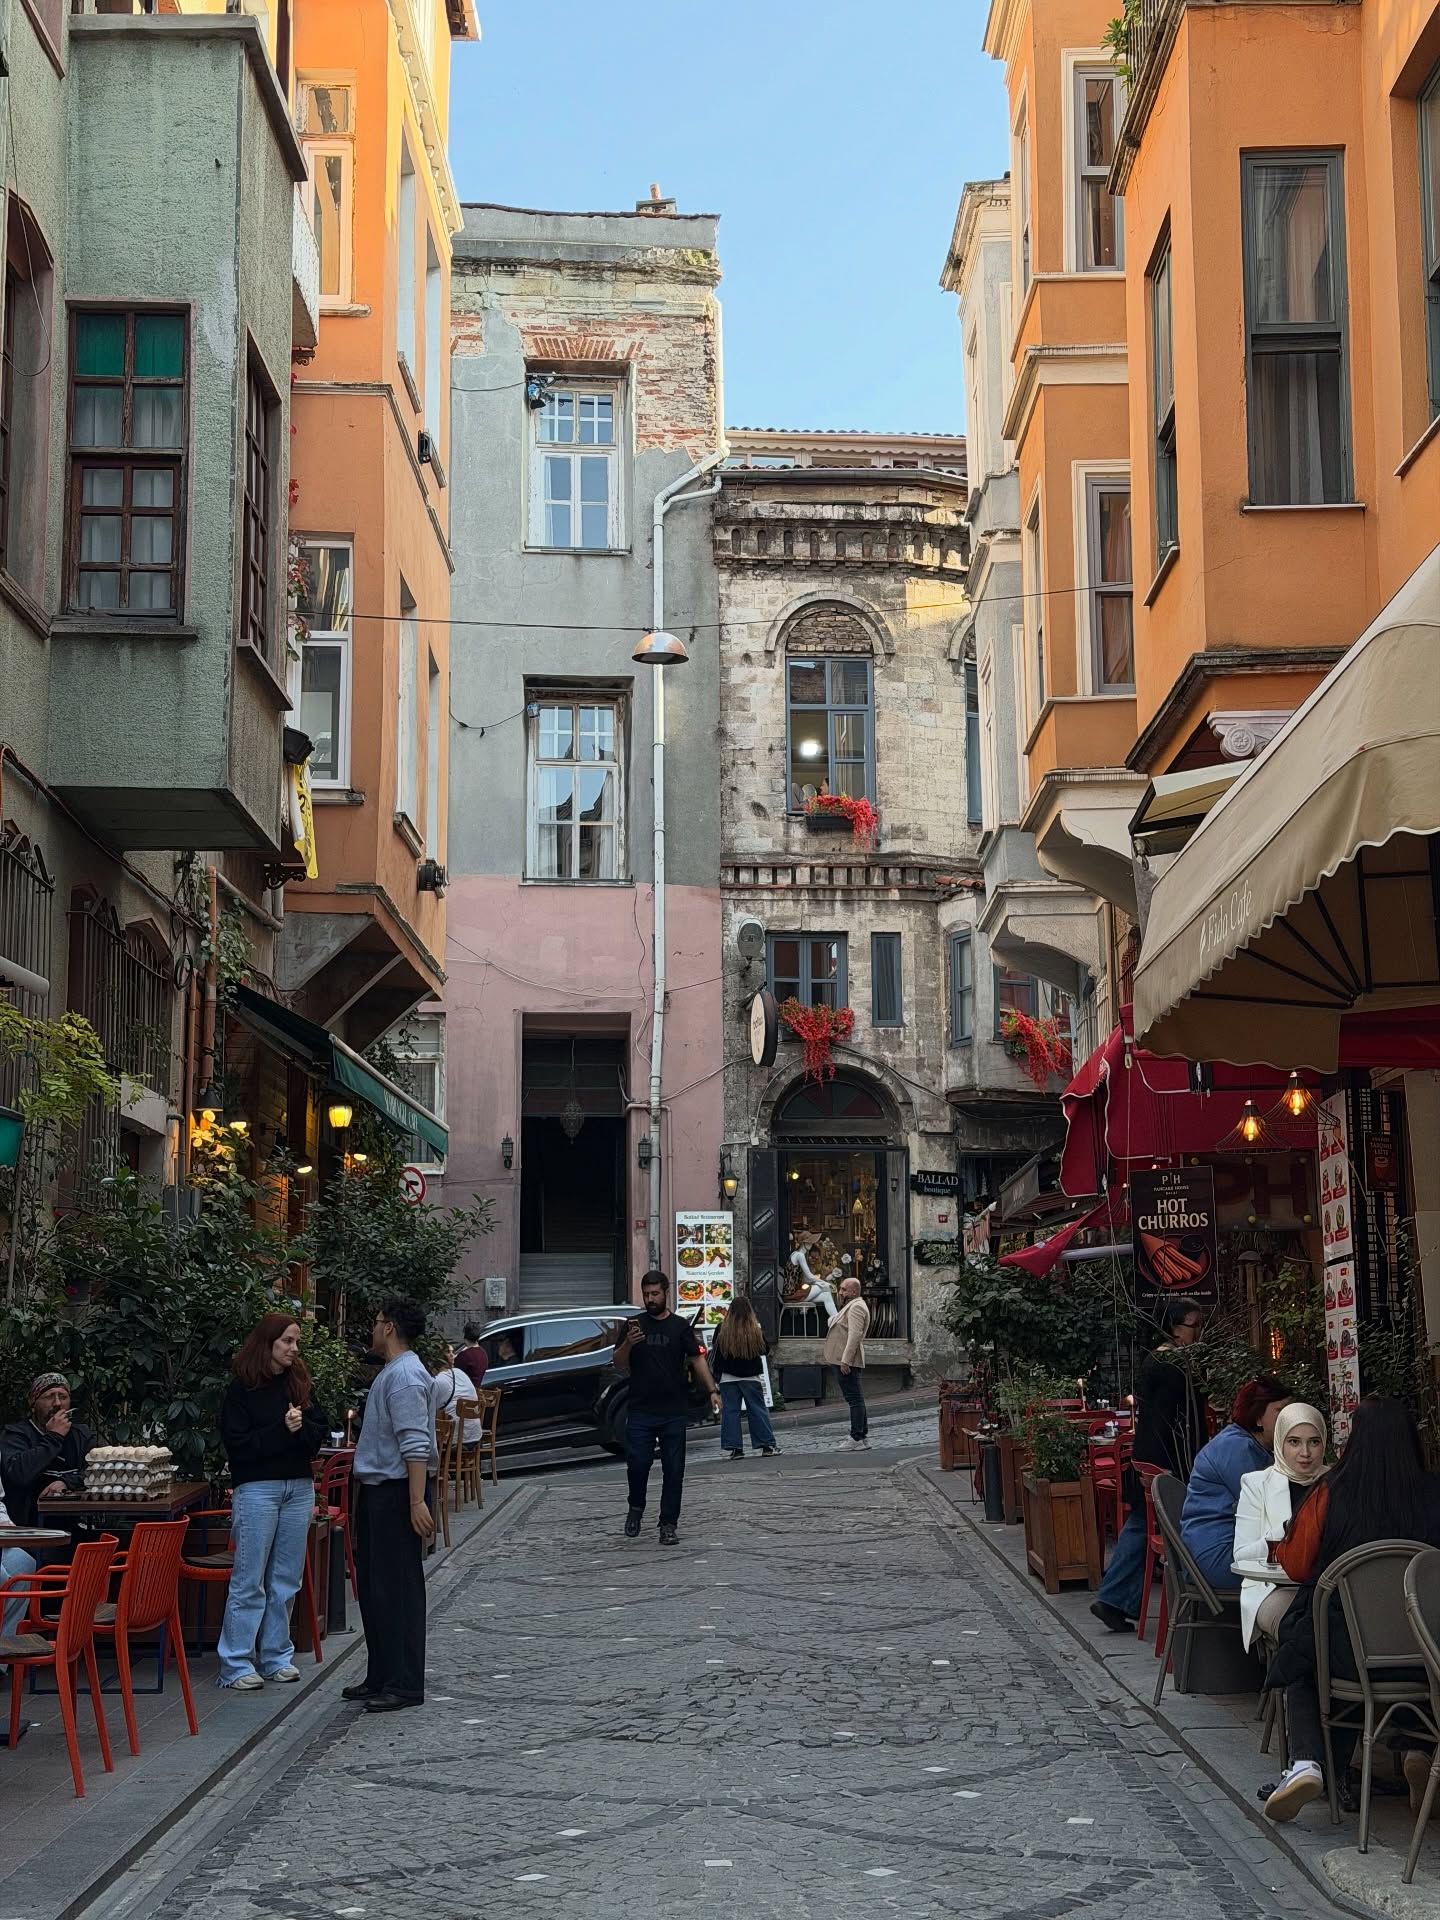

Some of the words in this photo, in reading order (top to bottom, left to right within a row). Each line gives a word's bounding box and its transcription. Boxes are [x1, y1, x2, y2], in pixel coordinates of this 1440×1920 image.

[1207, 904, 1228, 952] Fida
[917, 1173, 959, 1186] BALLAD
[924, 1184, 951, 1195] boutique
[1157, 1198, 1188, 1214] HOT
[1138, 1212, 1209, 1230] CHURROS
